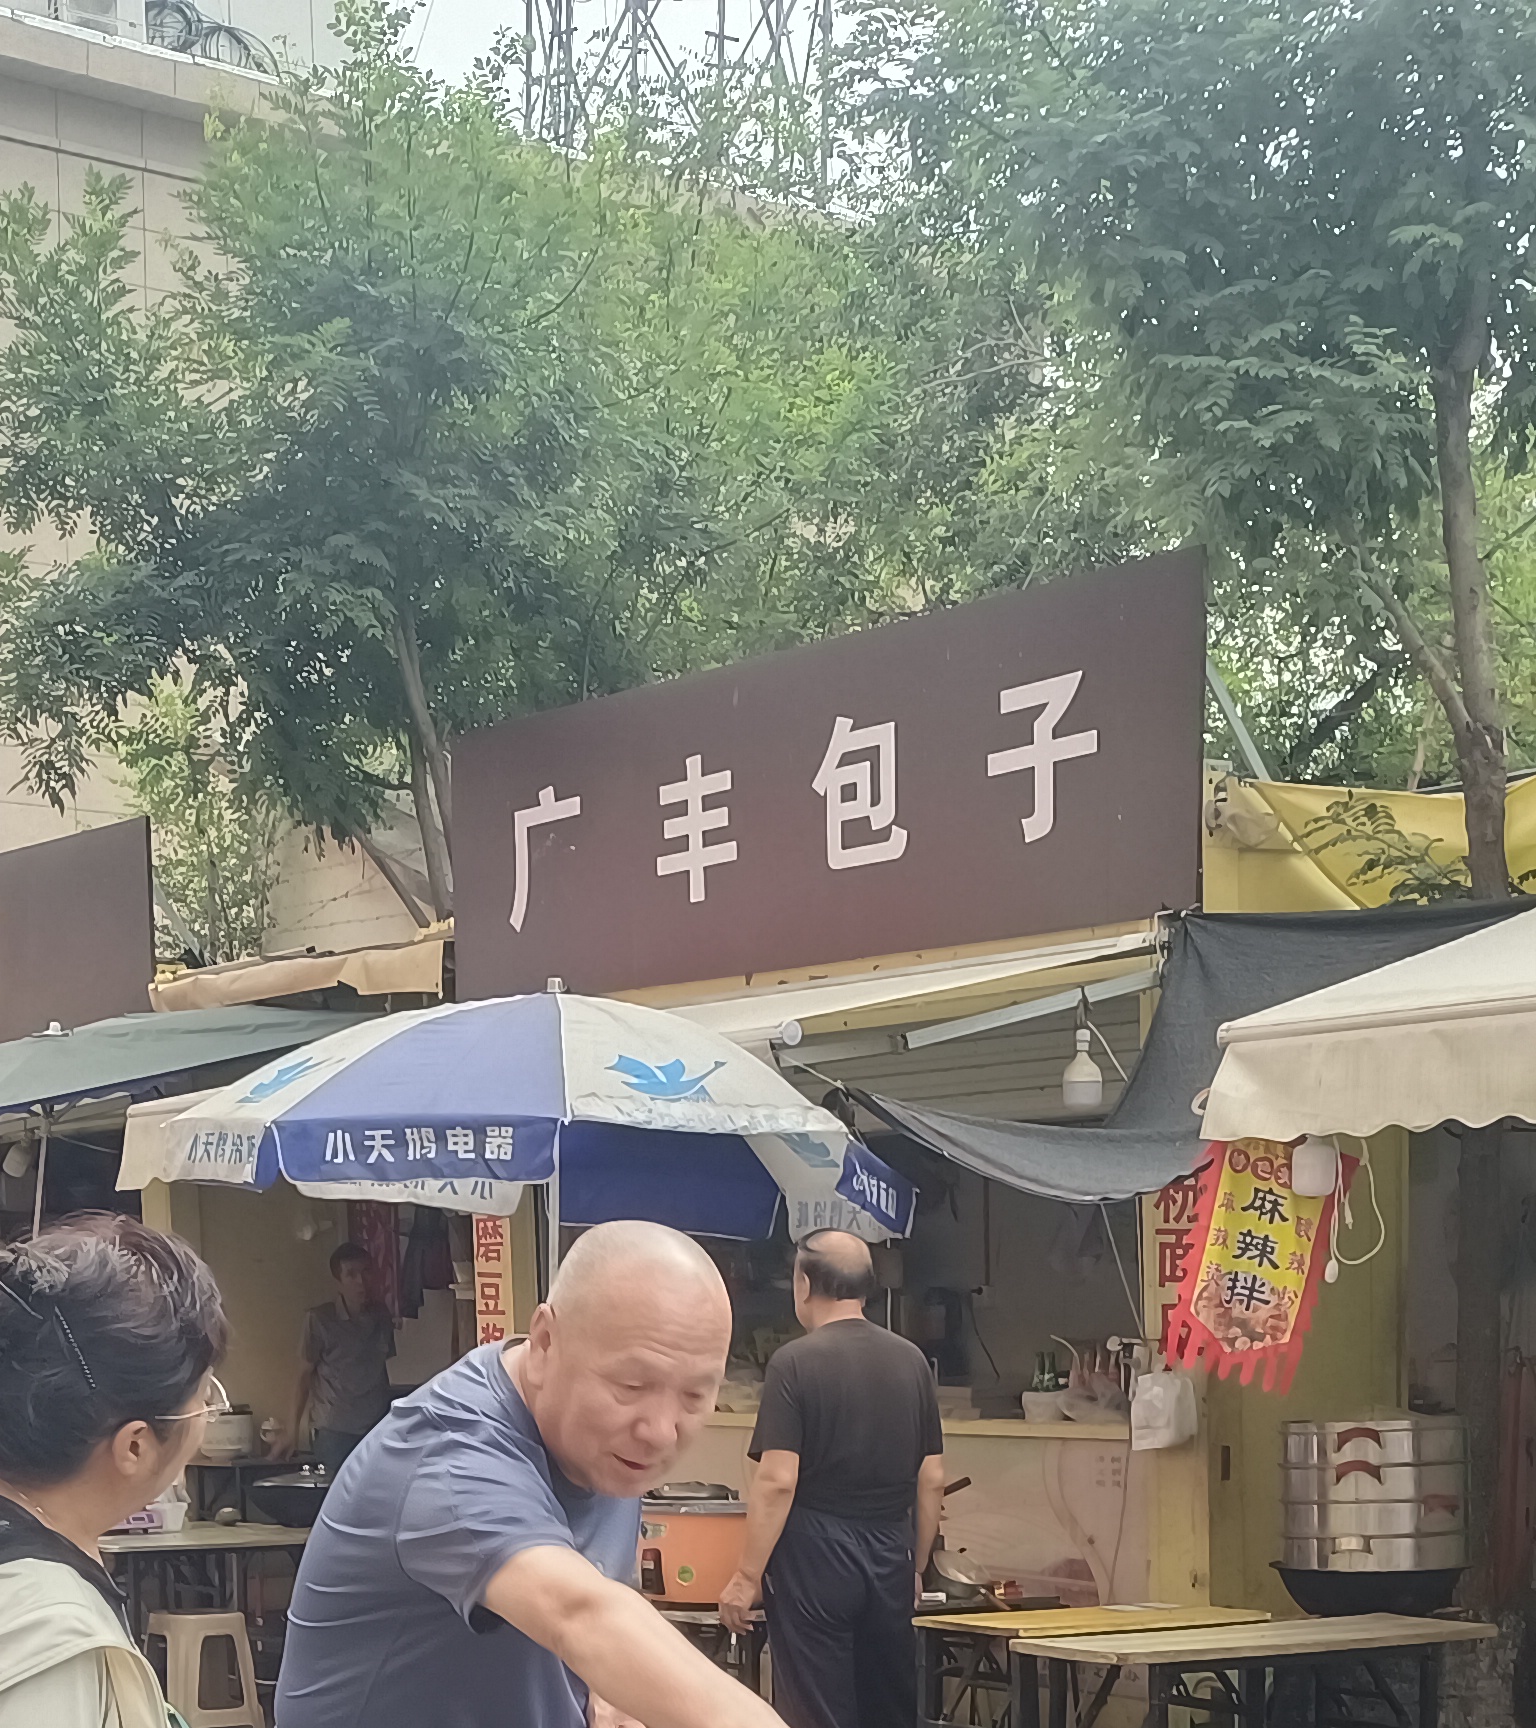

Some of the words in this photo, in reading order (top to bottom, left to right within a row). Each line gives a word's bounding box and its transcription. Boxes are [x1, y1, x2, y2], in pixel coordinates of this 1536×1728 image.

[509, 670, 1098, 933] 广丰包子
[324, 1125, 514, 1164] 小天鹅电器
[1223, 1186, 1290, 1312] 麻辣拌
